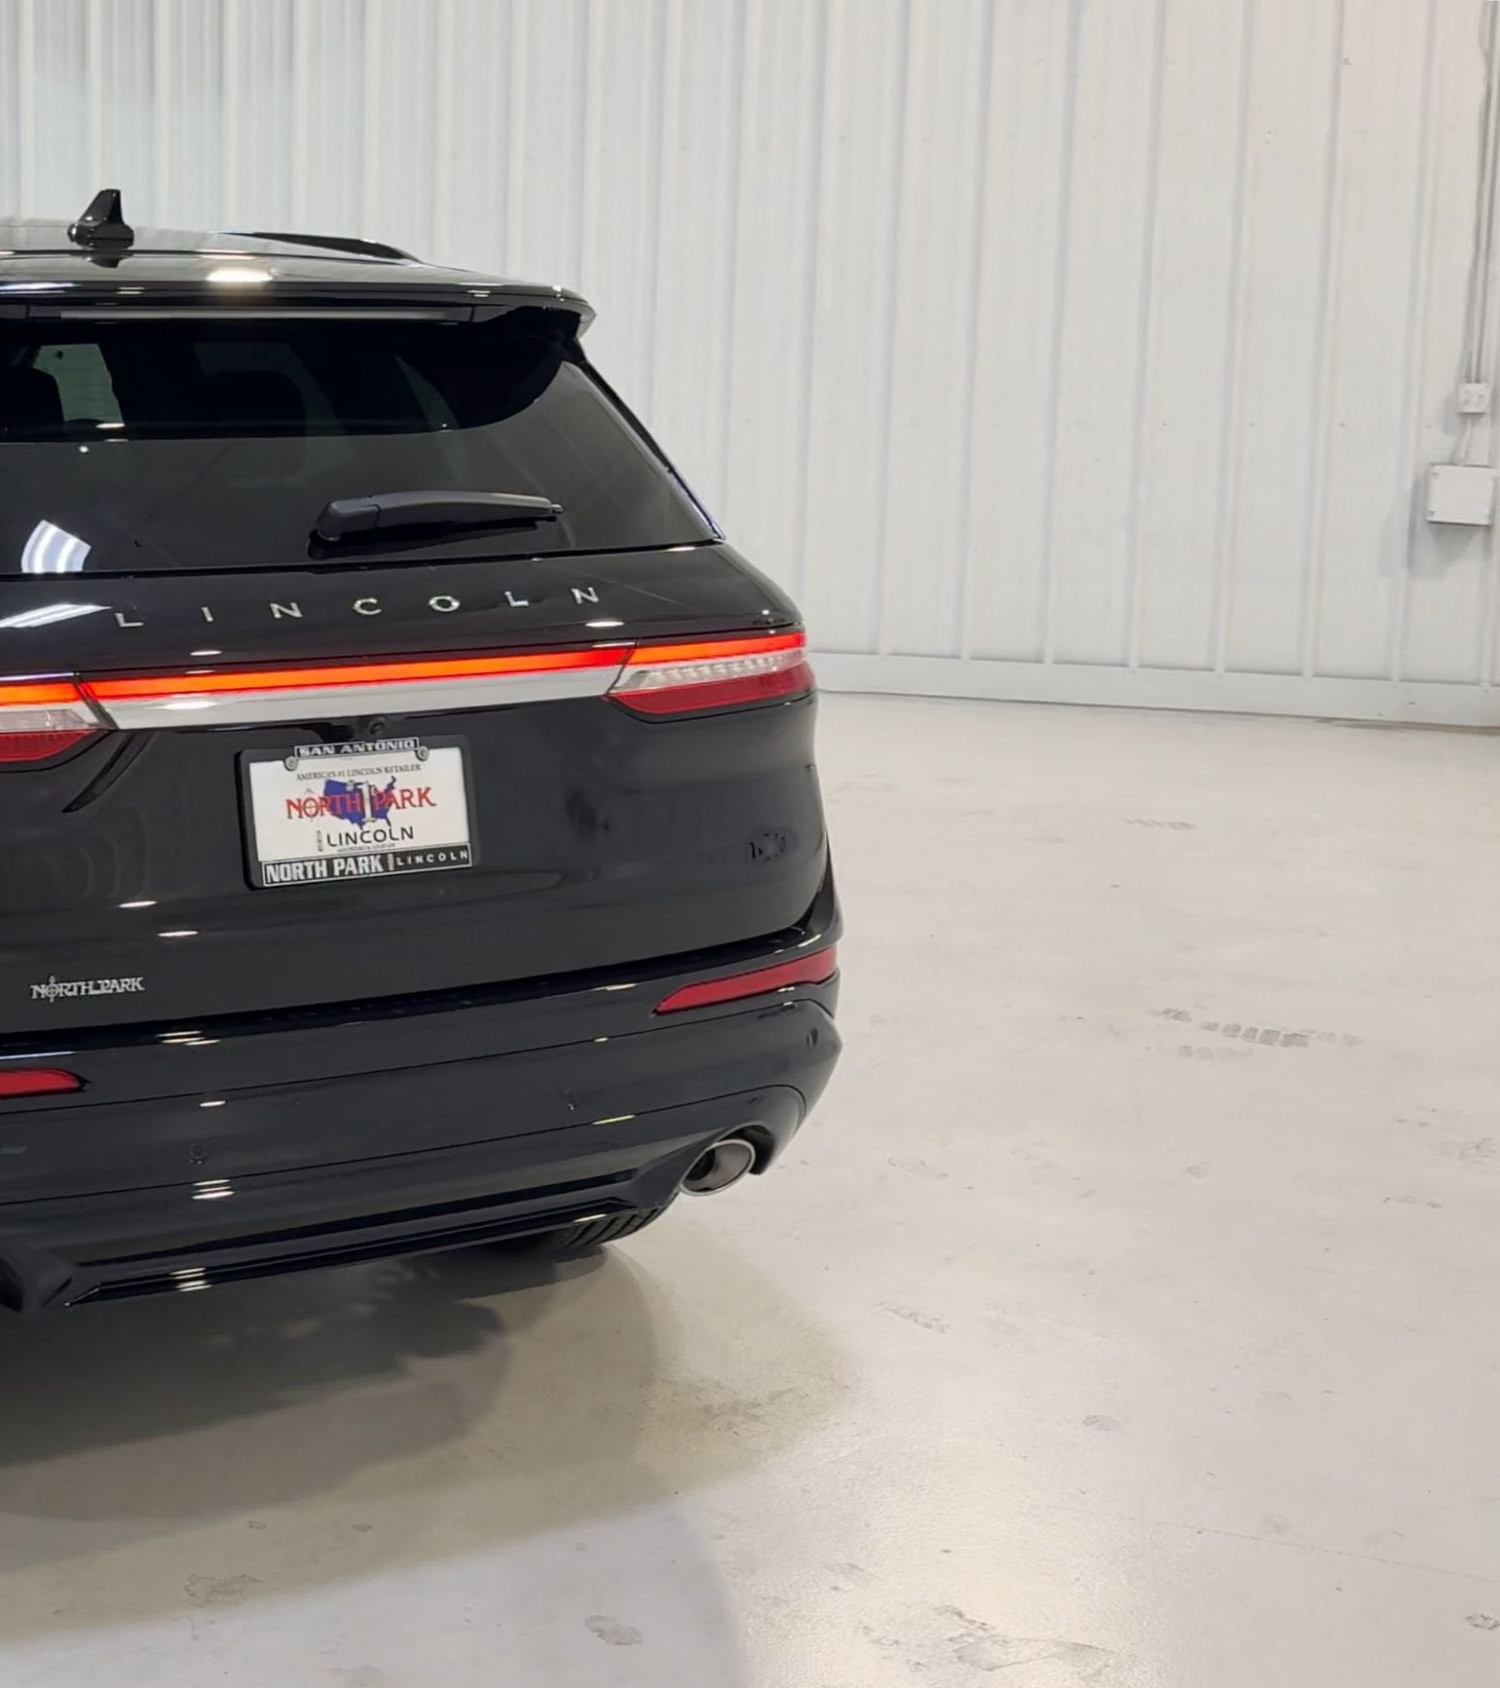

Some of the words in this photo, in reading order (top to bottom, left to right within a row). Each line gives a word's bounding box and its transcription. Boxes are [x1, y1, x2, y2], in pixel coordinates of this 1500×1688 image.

[114, 586, 601, 629] LINCOLN
[299, 744, 336, 758] SAN
[340, 739, 415, 754] ANTONIO
[347, 766, 383, 778] LINCOLN
[384, 764, 421, 775] RETAILER
[286, 791, 362, 820] NORTH
[373, 787, 437, 811] PARK
[326, 826, 415, 848] LINCOLN
[266, 858, 330, 884] NORTH
[333, 853, 384, 876] PARK
[396, 849, 469, 867] LINCOLN
[30, 976, 93, 1002] NORTH
[95, 977, 145, 995] PARK
